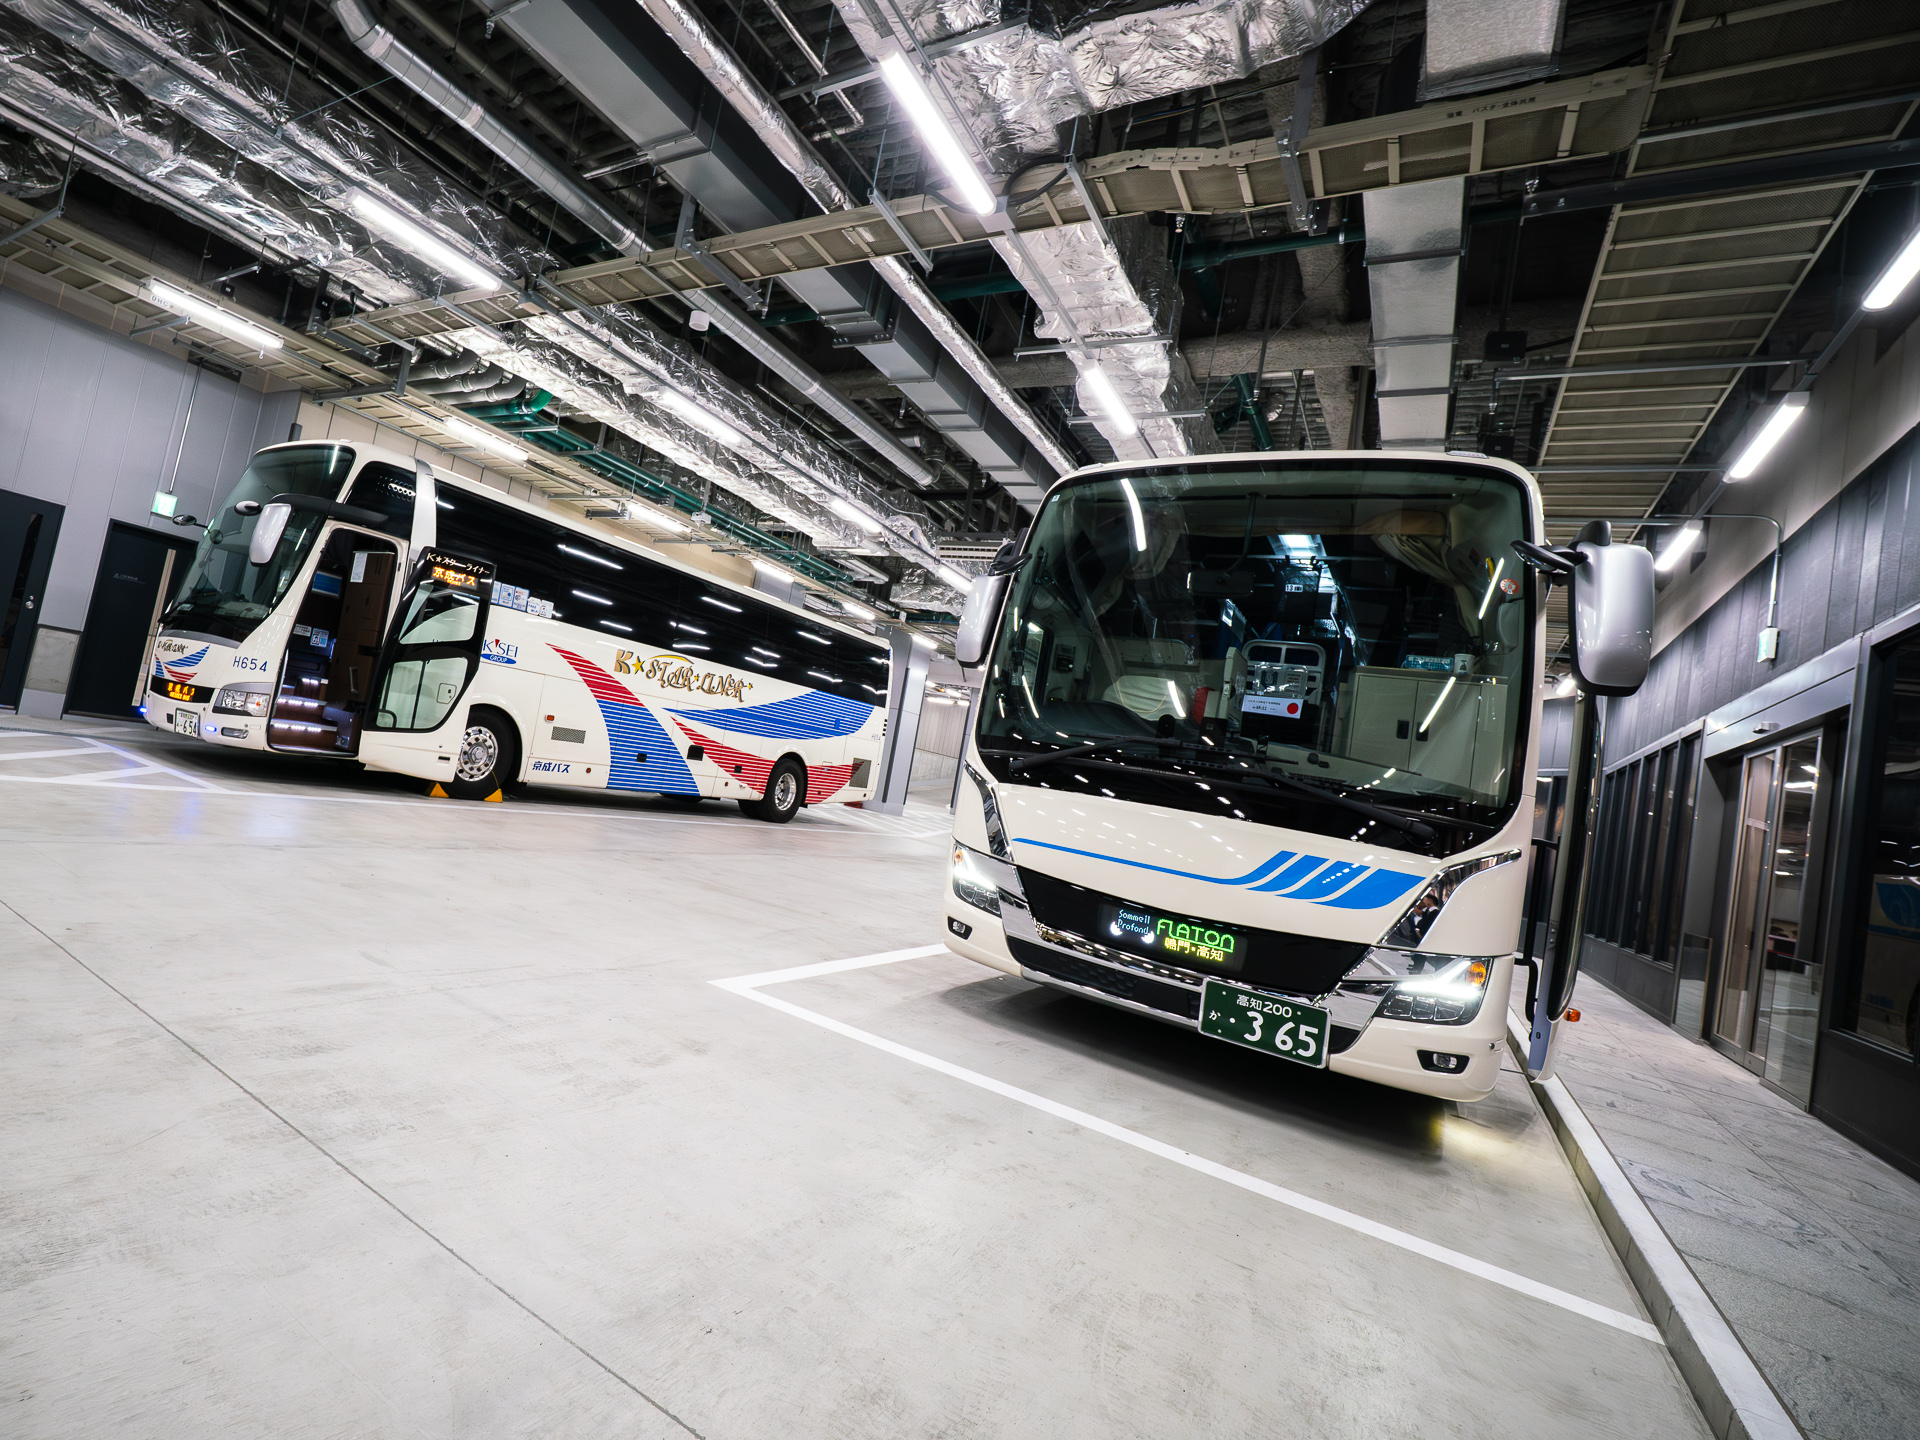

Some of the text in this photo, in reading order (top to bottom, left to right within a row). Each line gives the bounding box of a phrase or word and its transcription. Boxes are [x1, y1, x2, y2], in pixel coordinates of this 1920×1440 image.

[152, 296, 168, 306] DHC
[433, 567, 475, 586] 京成バス
[232, 655, 268, 673] H654
[489, 654, 508, 663] GROUP
[645, 658, 694, 693] STAR
[696, 672, 745, 703] LINER
[532, 760, 570, 773] 京成バス
[1118, 909, 1151, 925] Sommeil
[1117, 919, 1149, 935] Profond
[1164, 937, 1224, 962] 鳴門・高知
[1208, 1009, 1221, 1021] か
